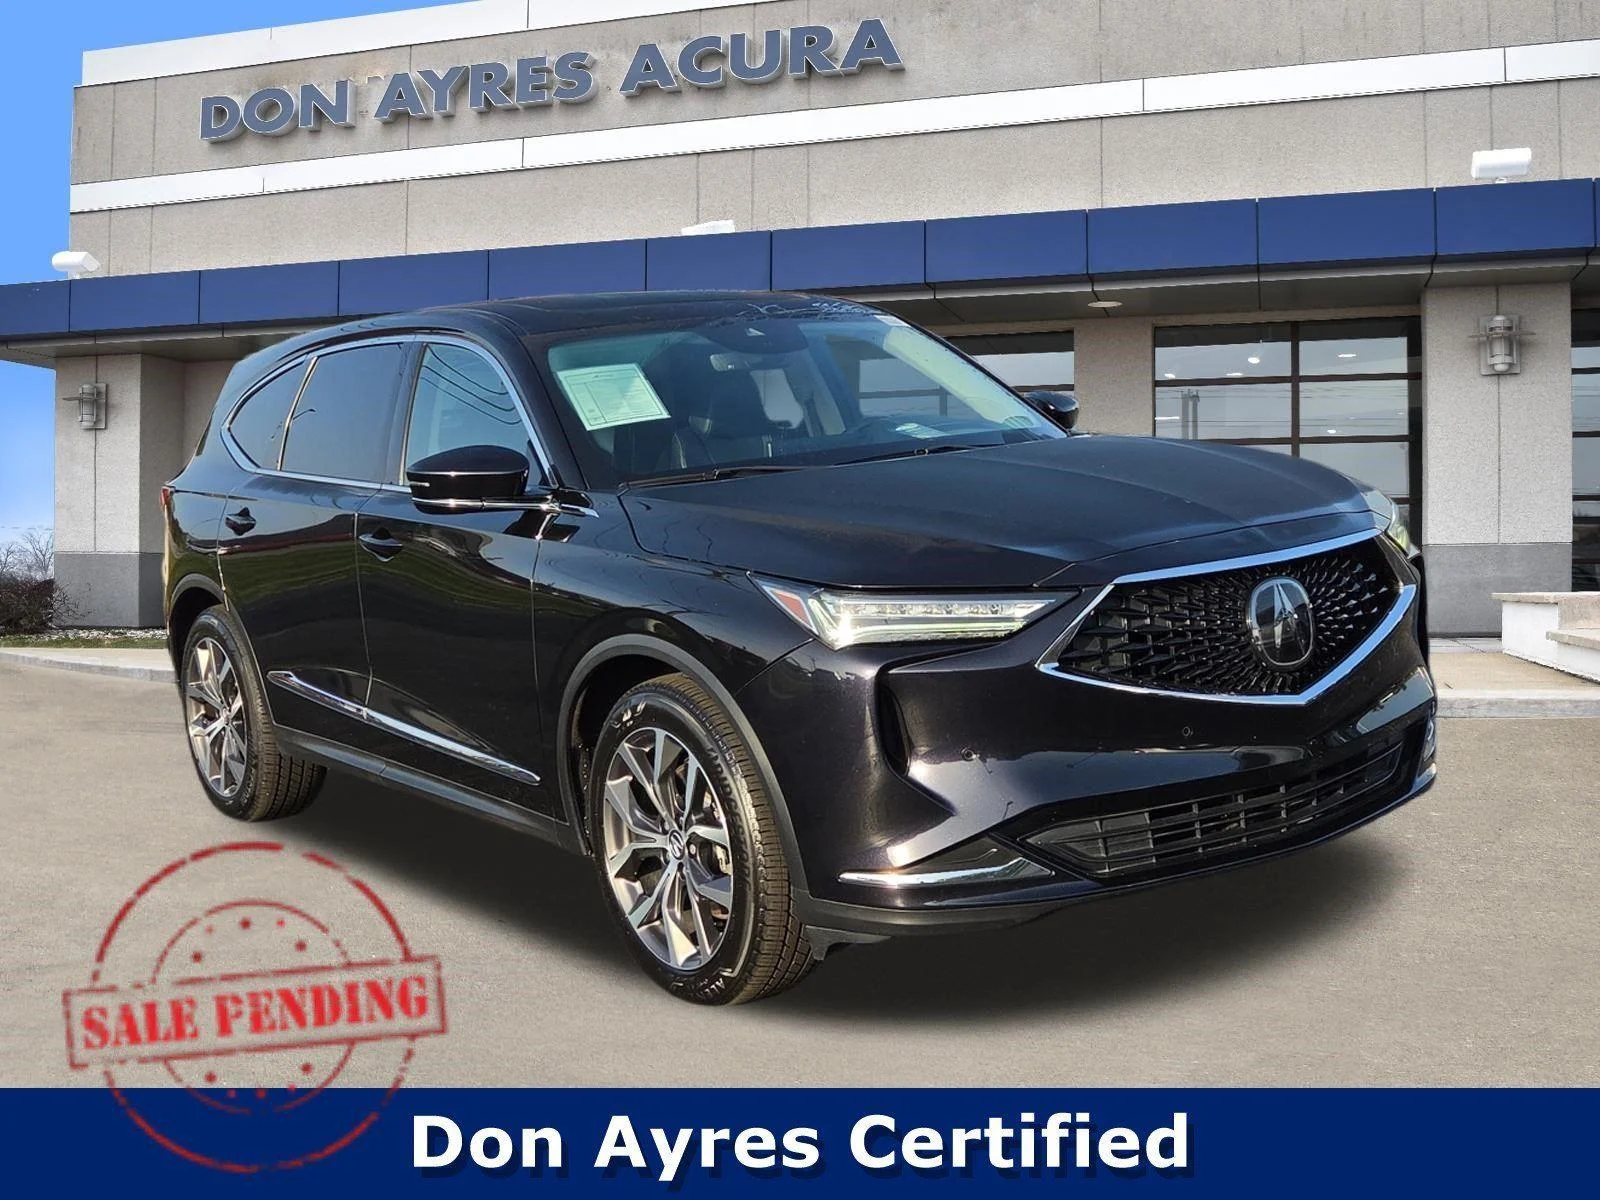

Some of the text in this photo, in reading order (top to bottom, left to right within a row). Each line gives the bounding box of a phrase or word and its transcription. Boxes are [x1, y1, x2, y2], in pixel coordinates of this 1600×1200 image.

[200, 18, 905, 142] DON AYRES ACURA
